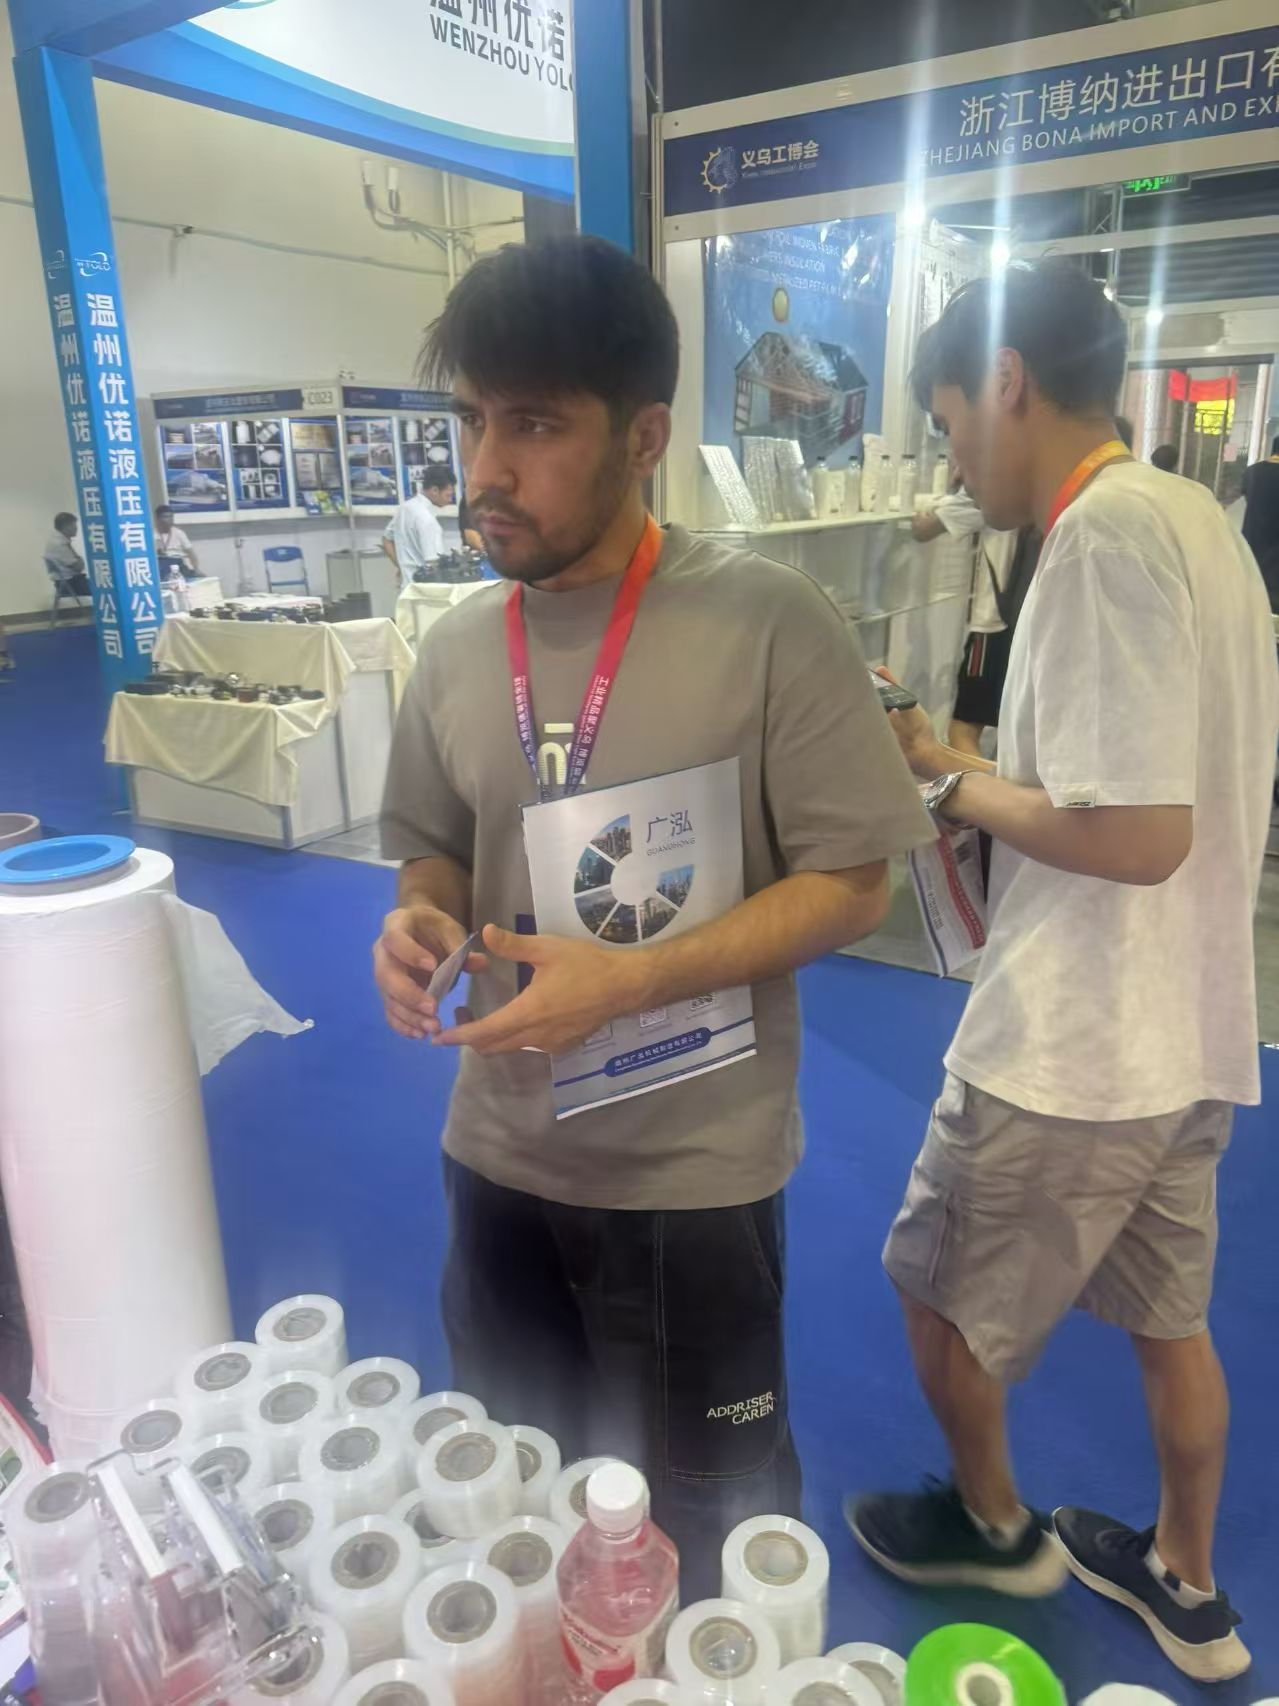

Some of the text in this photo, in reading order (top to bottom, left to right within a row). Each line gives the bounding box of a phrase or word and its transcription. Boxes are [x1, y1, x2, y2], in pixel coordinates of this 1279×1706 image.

[430, 14, 530, 75] WENZHOU
[741, 139, 819, 169] 义乌工博会
[920, 94, 1279, 167] ZHEJIANG BONA IMPORT AND EX
[53, 293, 123, 658] 温州优诺液压有限公司
[86, 293, 160, 656] 温州优诺液压有限公司
[646, 809, 693, 843] 广泓
[706, 1391, 775, 1418] ADDRISER
[732, 1401, 774, 1424] CAREN
